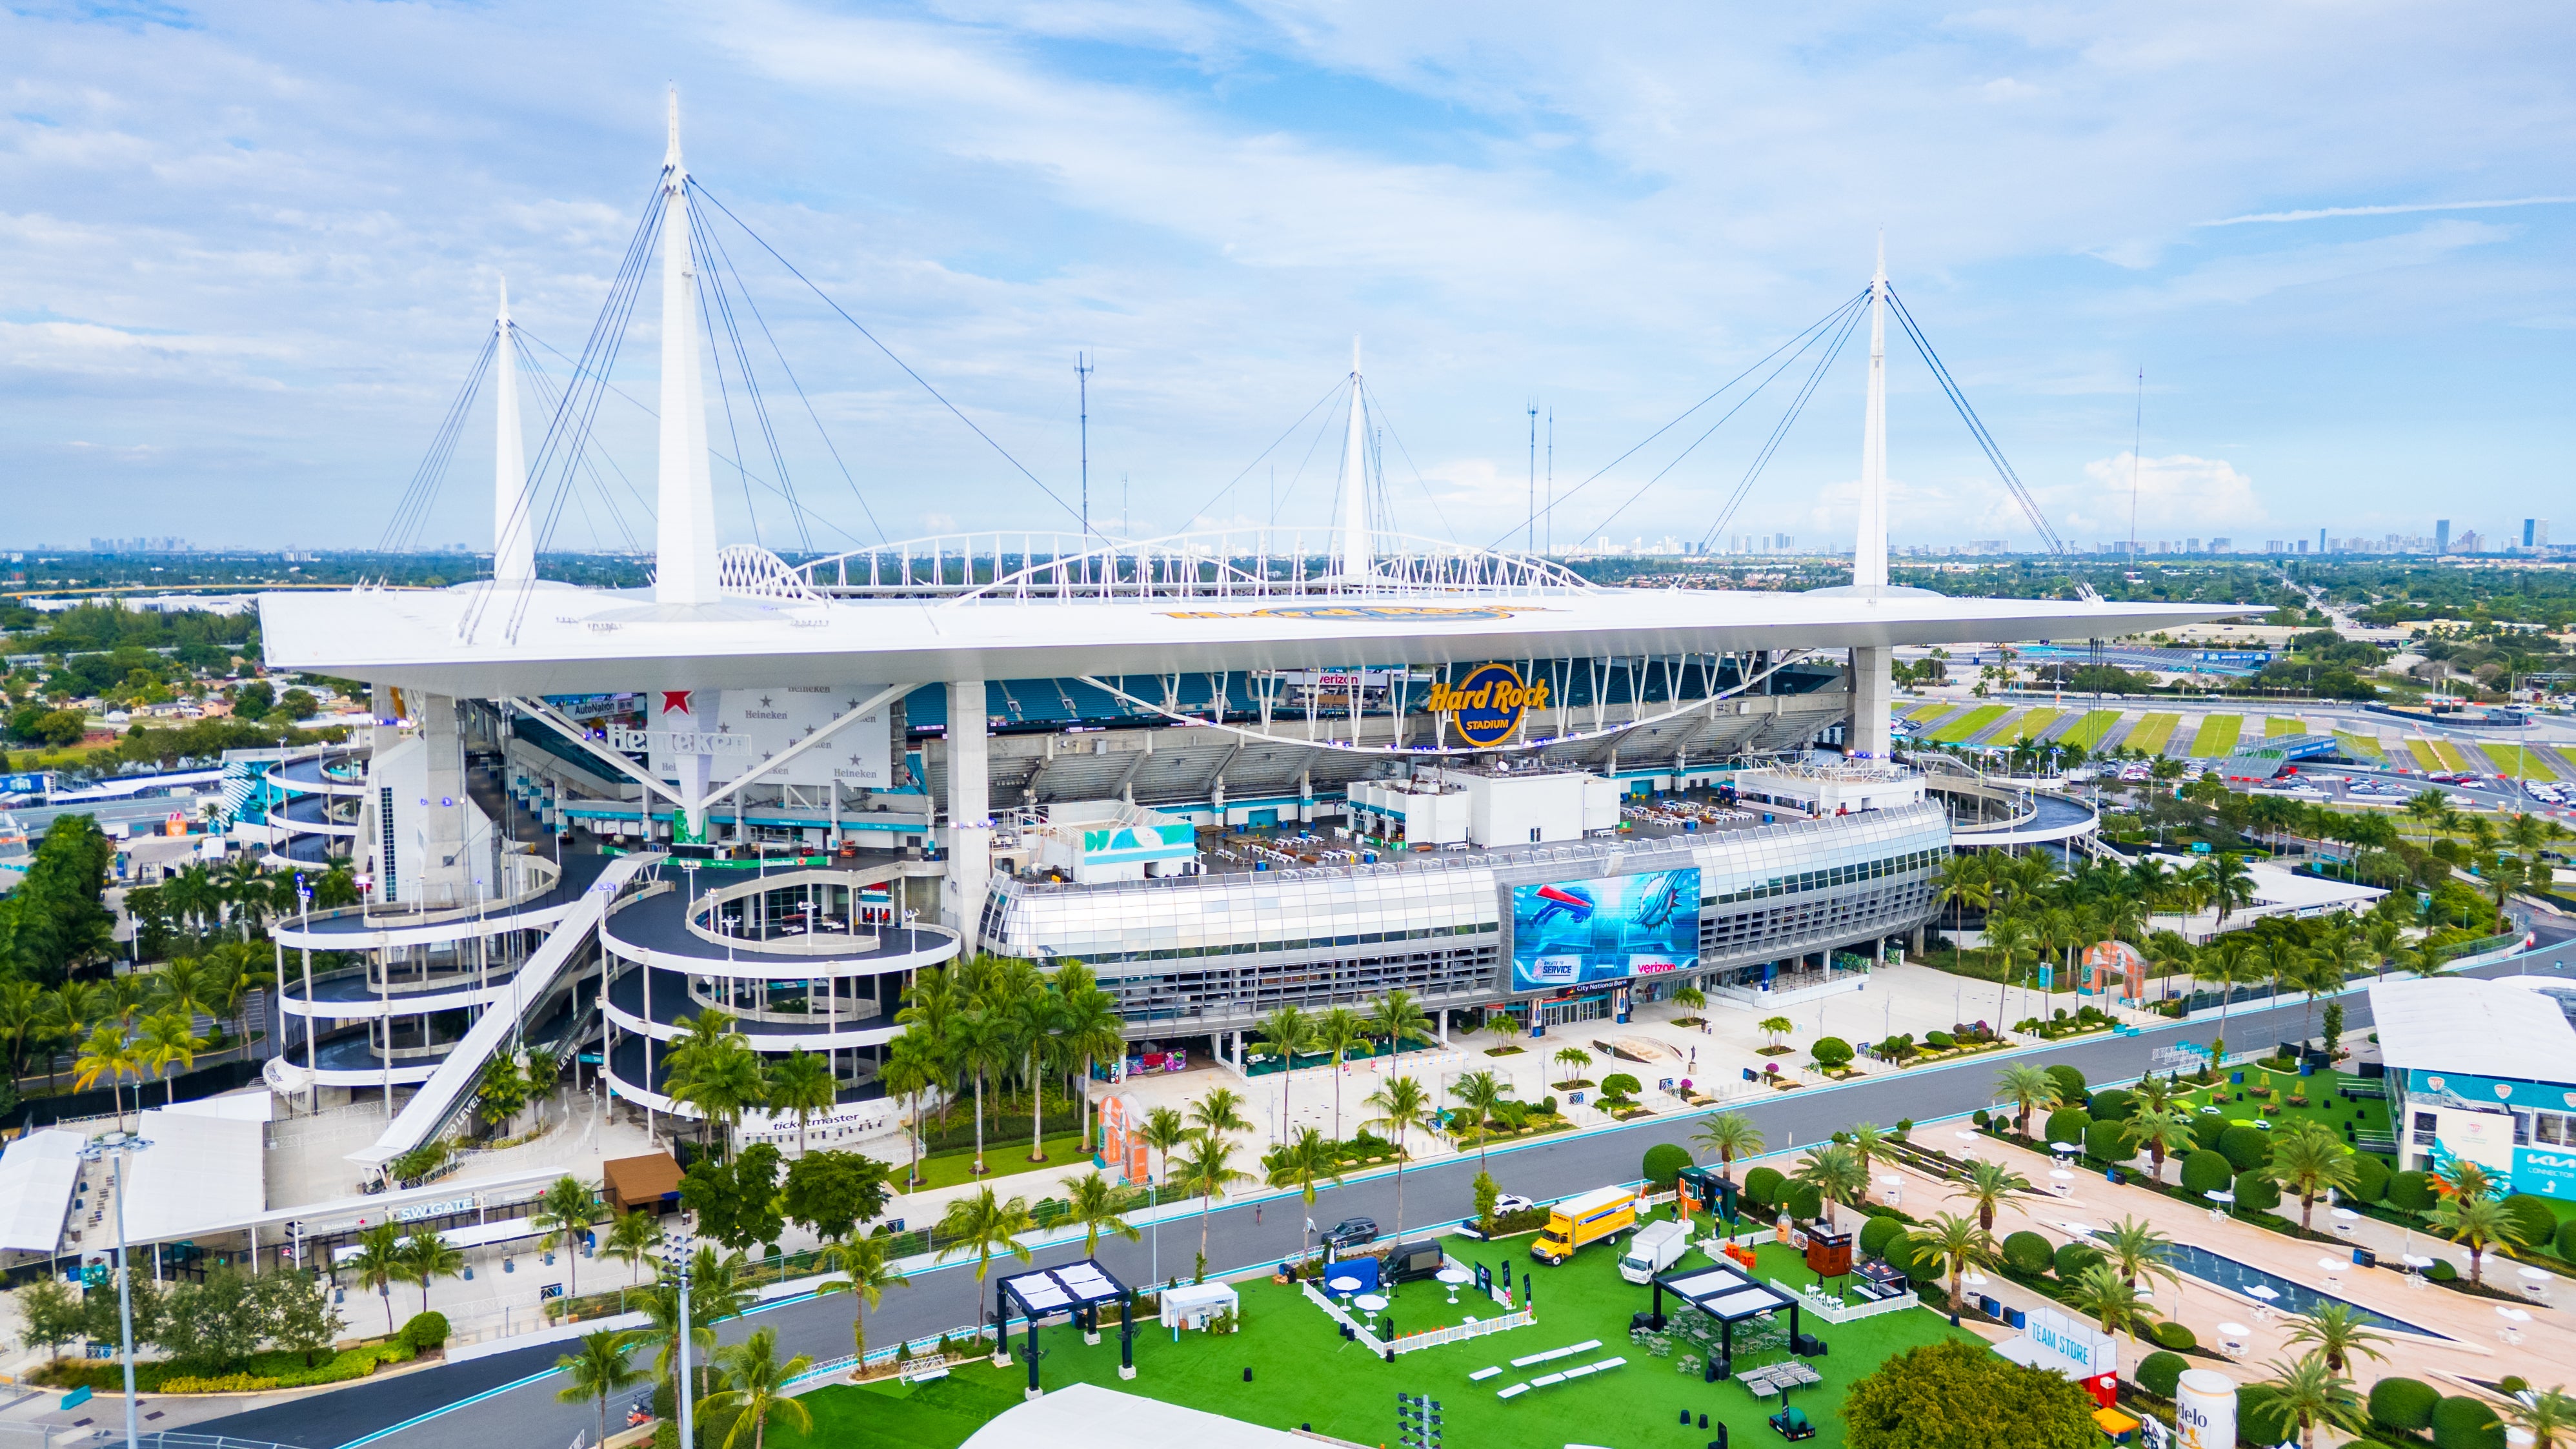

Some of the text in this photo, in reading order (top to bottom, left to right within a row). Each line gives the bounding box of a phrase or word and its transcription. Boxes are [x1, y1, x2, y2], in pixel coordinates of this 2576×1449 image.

[1428, 679, 1549, 714] Hard Rock
[575, 702, 615, 716] AutoNation
[745, 710, 788, 720] Heineken
[1466, 719, 1509, 731] STADIUM
[834, 768, 877, 778] Heineken
[1543, 965, 1572, 975] SERVICE
[1637, 962, 1676, 974] verizon
[1590, 981, 1613, 990] National
[558, 1042, 579, 1071] LEVEL
[456, 1095, 482, 1127] LEVEL
[773, 1113, 860, 1131] ticktmaster
[2527, 1167, 2575, 1179] CONNECTOR
[401, 1198, 473, 1221] SW GATE
[321, 1220, 357, 1231] Heineken
[2032, 1321, 2088, 1366] TEAM STORE
[2177, 1402, 2208, 1428] delo
